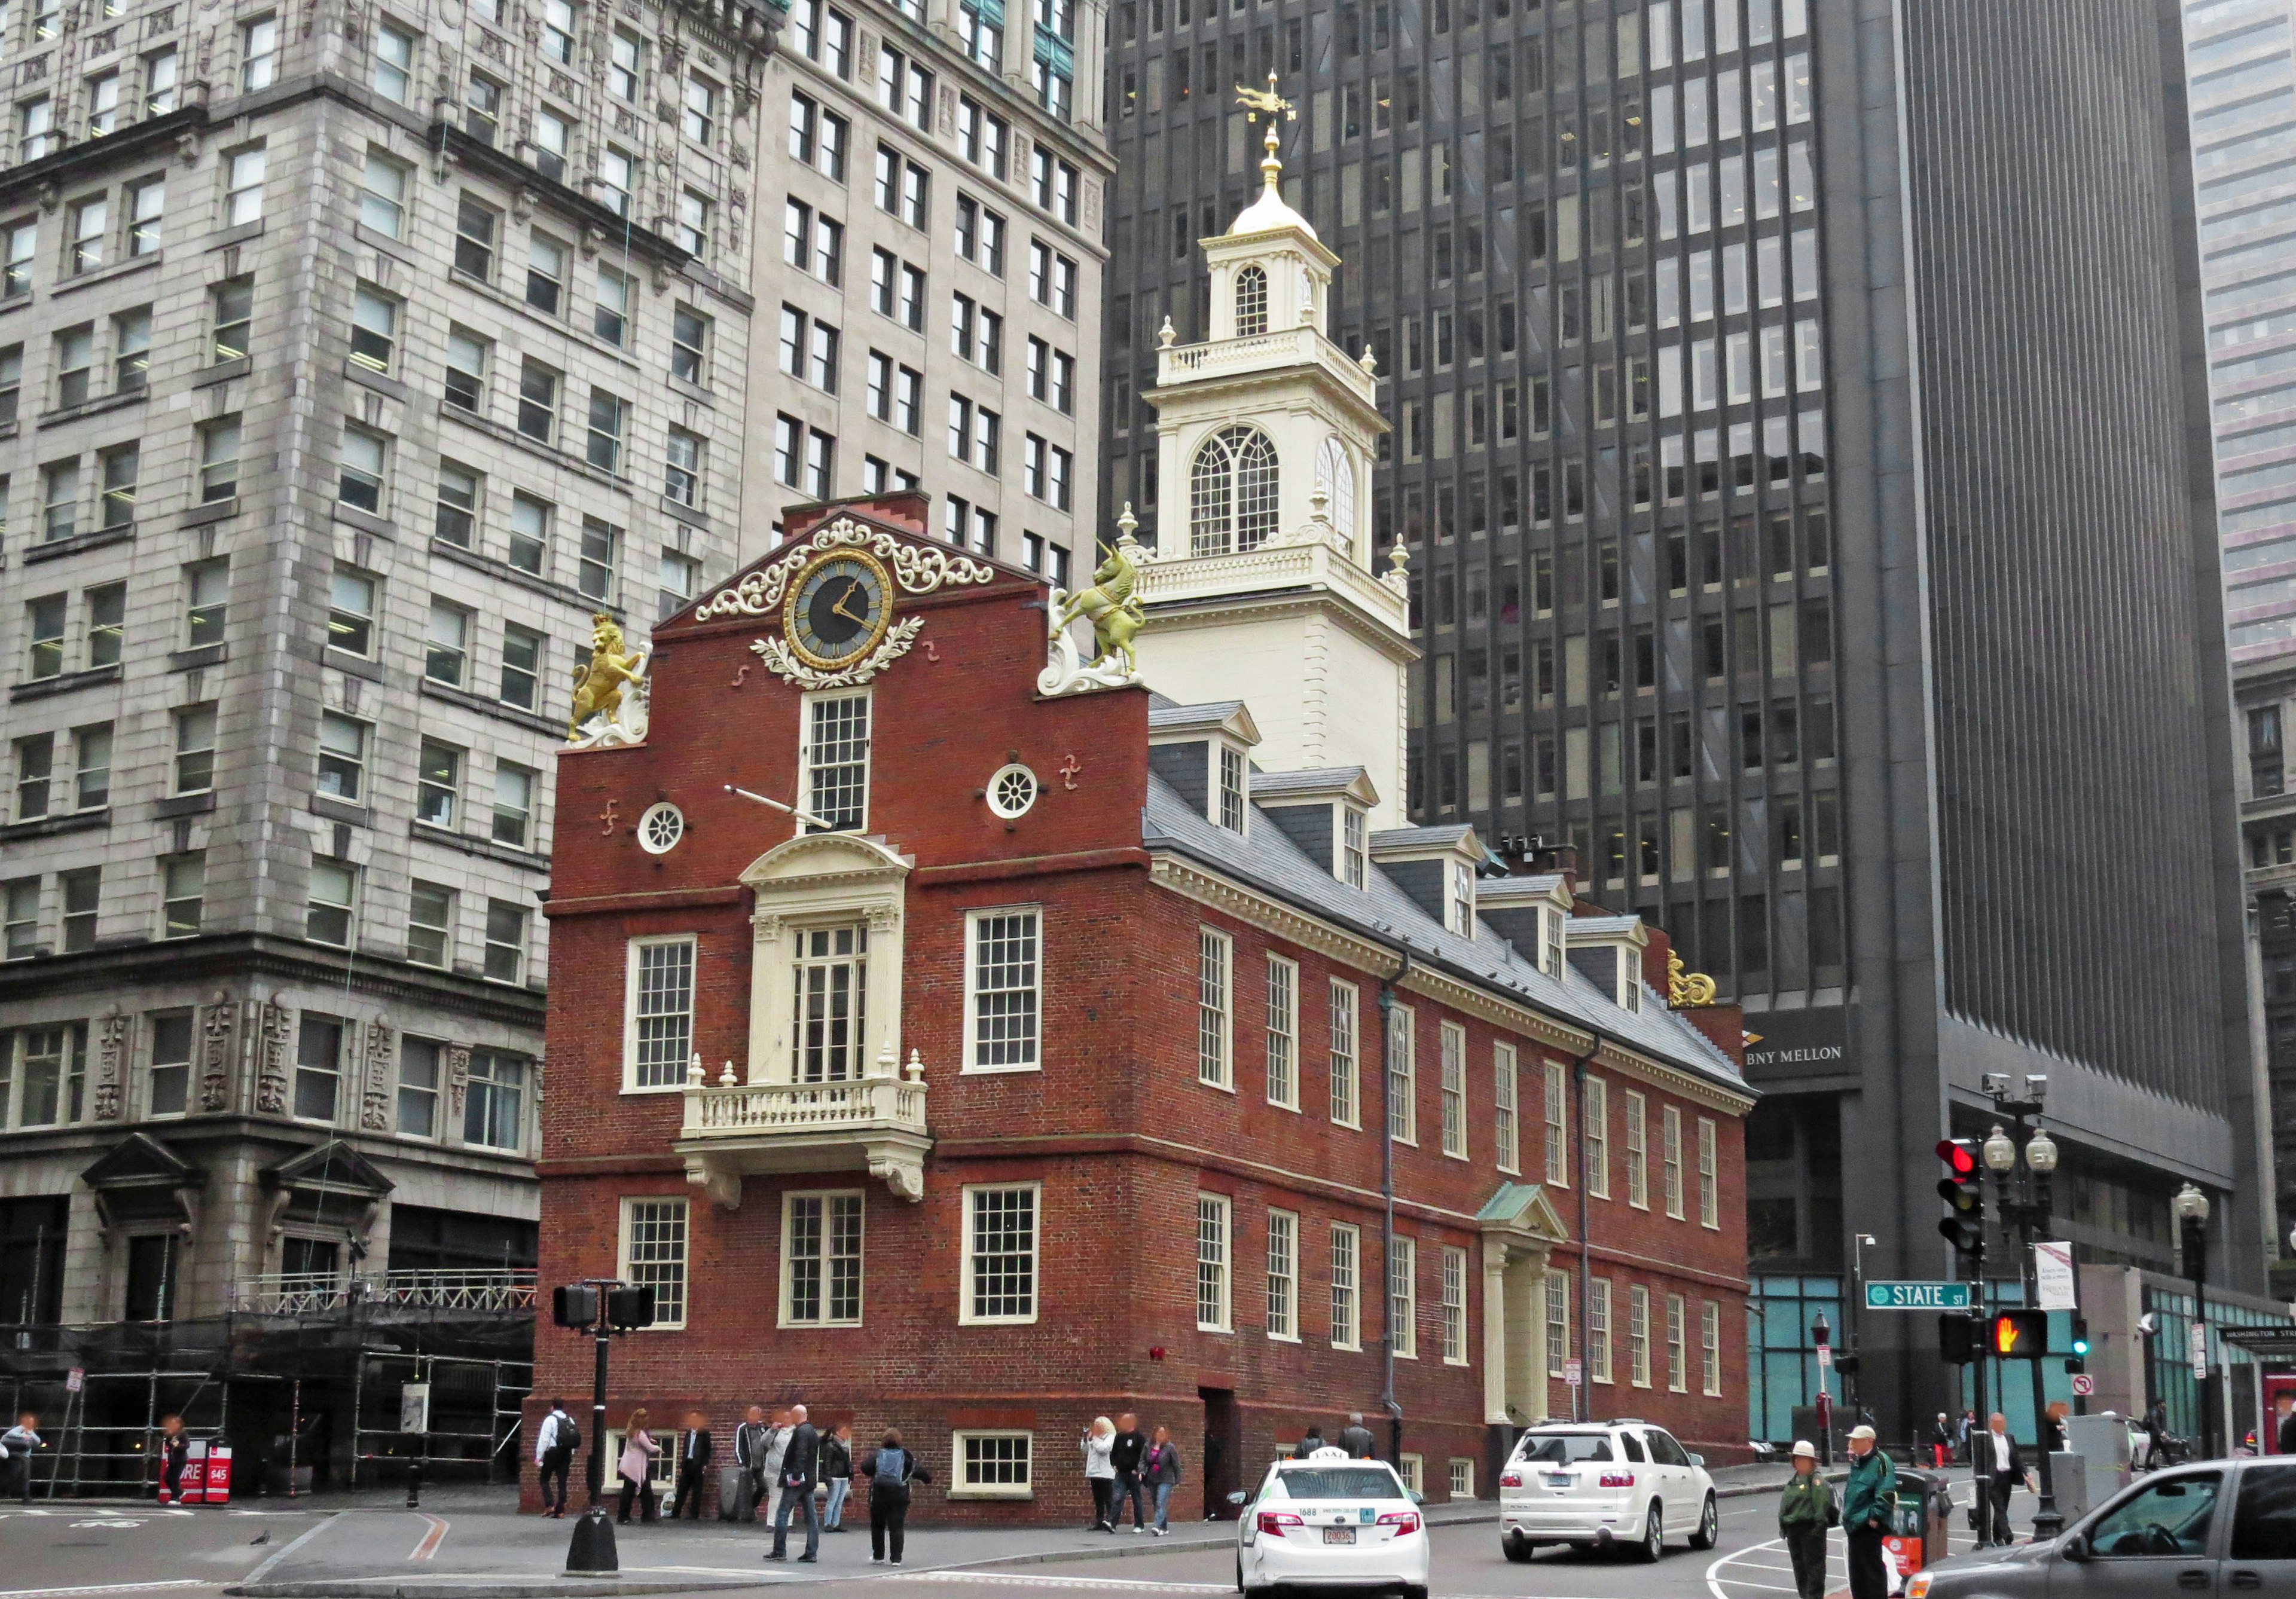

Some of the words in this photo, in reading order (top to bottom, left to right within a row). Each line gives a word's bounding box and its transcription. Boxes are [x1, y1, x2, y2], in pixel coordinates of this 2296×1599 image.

[1287, 110, 1297, 121] N
[1745, 1051, 1776, 1066] BNY
[1780, 1046, 1842, 1063] MELLON
[1893, 1286, 1944, 1305] STATE
[1952, 1295, 1964, 1305] ST
[1315, 1451, 1344, 1459] TAXI
[210, 1469, 227, 1480] $45
[1299, 1508, 1317, 1517] 1688
